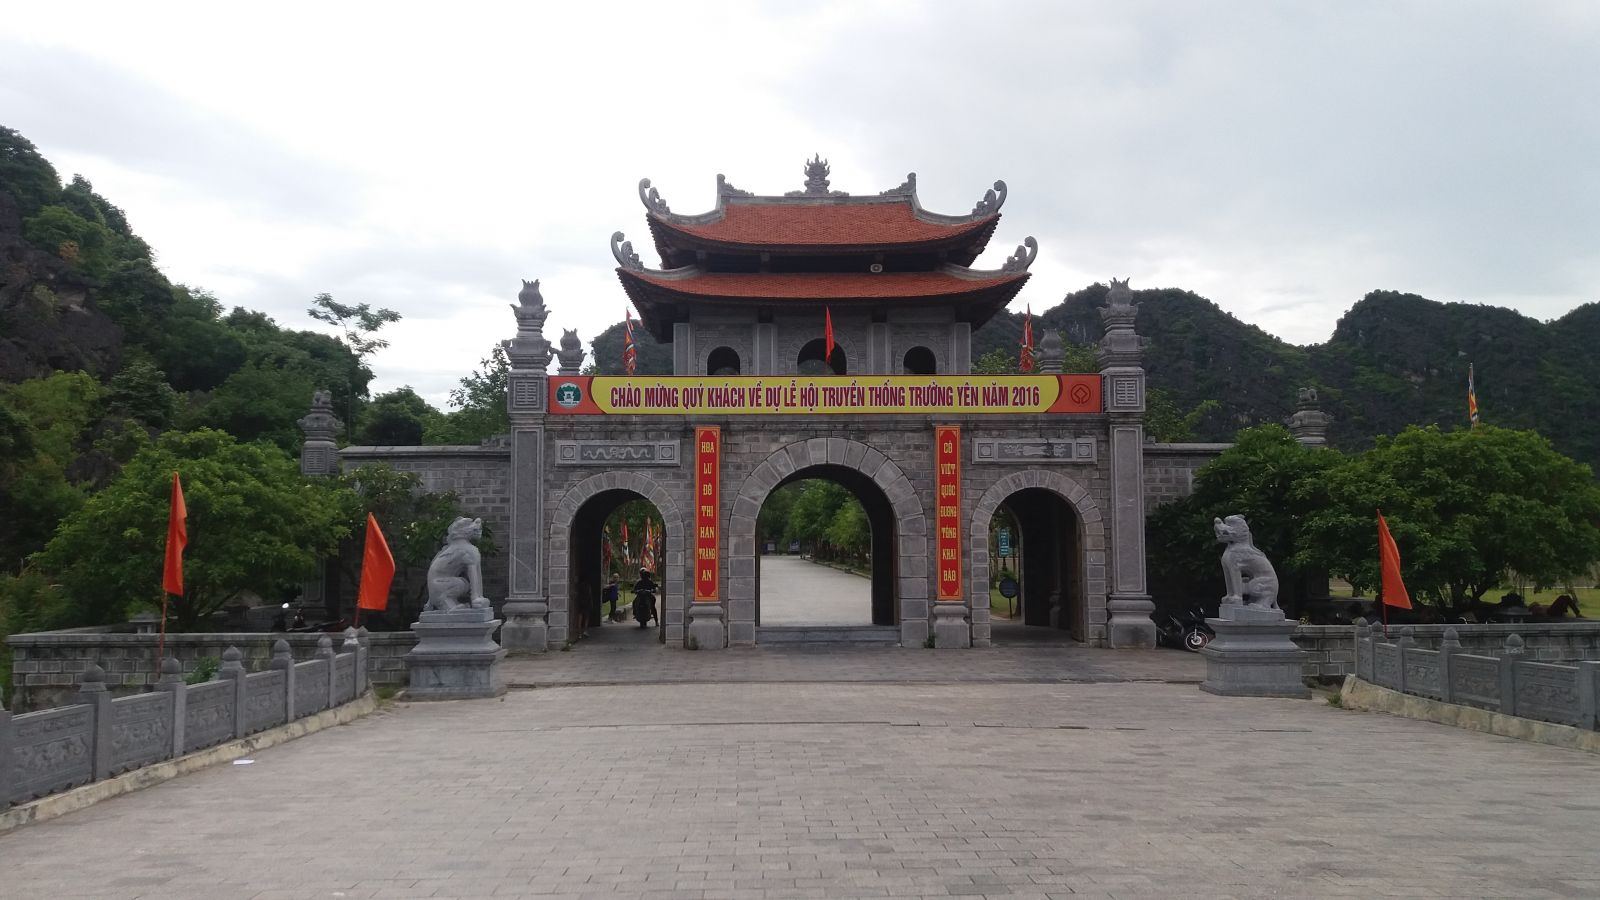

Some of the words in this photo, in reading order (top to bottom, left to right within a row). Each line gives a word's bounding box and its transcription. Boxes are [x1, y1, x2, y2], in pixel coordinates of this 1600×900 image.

[611, 383, 641, 407] CHÀO
[645, 383, 679, 407] MỪNG
[682, 383, 704, 410] QUÝ
[708, 383, 745, 407] KHÁCH
[749, 381, 762, 407] VỀ
[766, 385, 782, 412] DỰ
[784, 380, 797, 407] LỄ
[801, 383, 819, 412] HỘI
[822, 380, 865, 407] TRUYỀN
[869, 379, 905, 407] THỐNG
[909, 381, 953, 407] TRƯỜNG
[957, 382, 979, 406] YÊN
[983, 382, 1008, 406] NĂM
[1012, 386, 1040, 406] 2016
[701, 441, 715, 453] HOA
[942, 548, 957, 560] KHAI
[701, 569, 712, 582] AN
